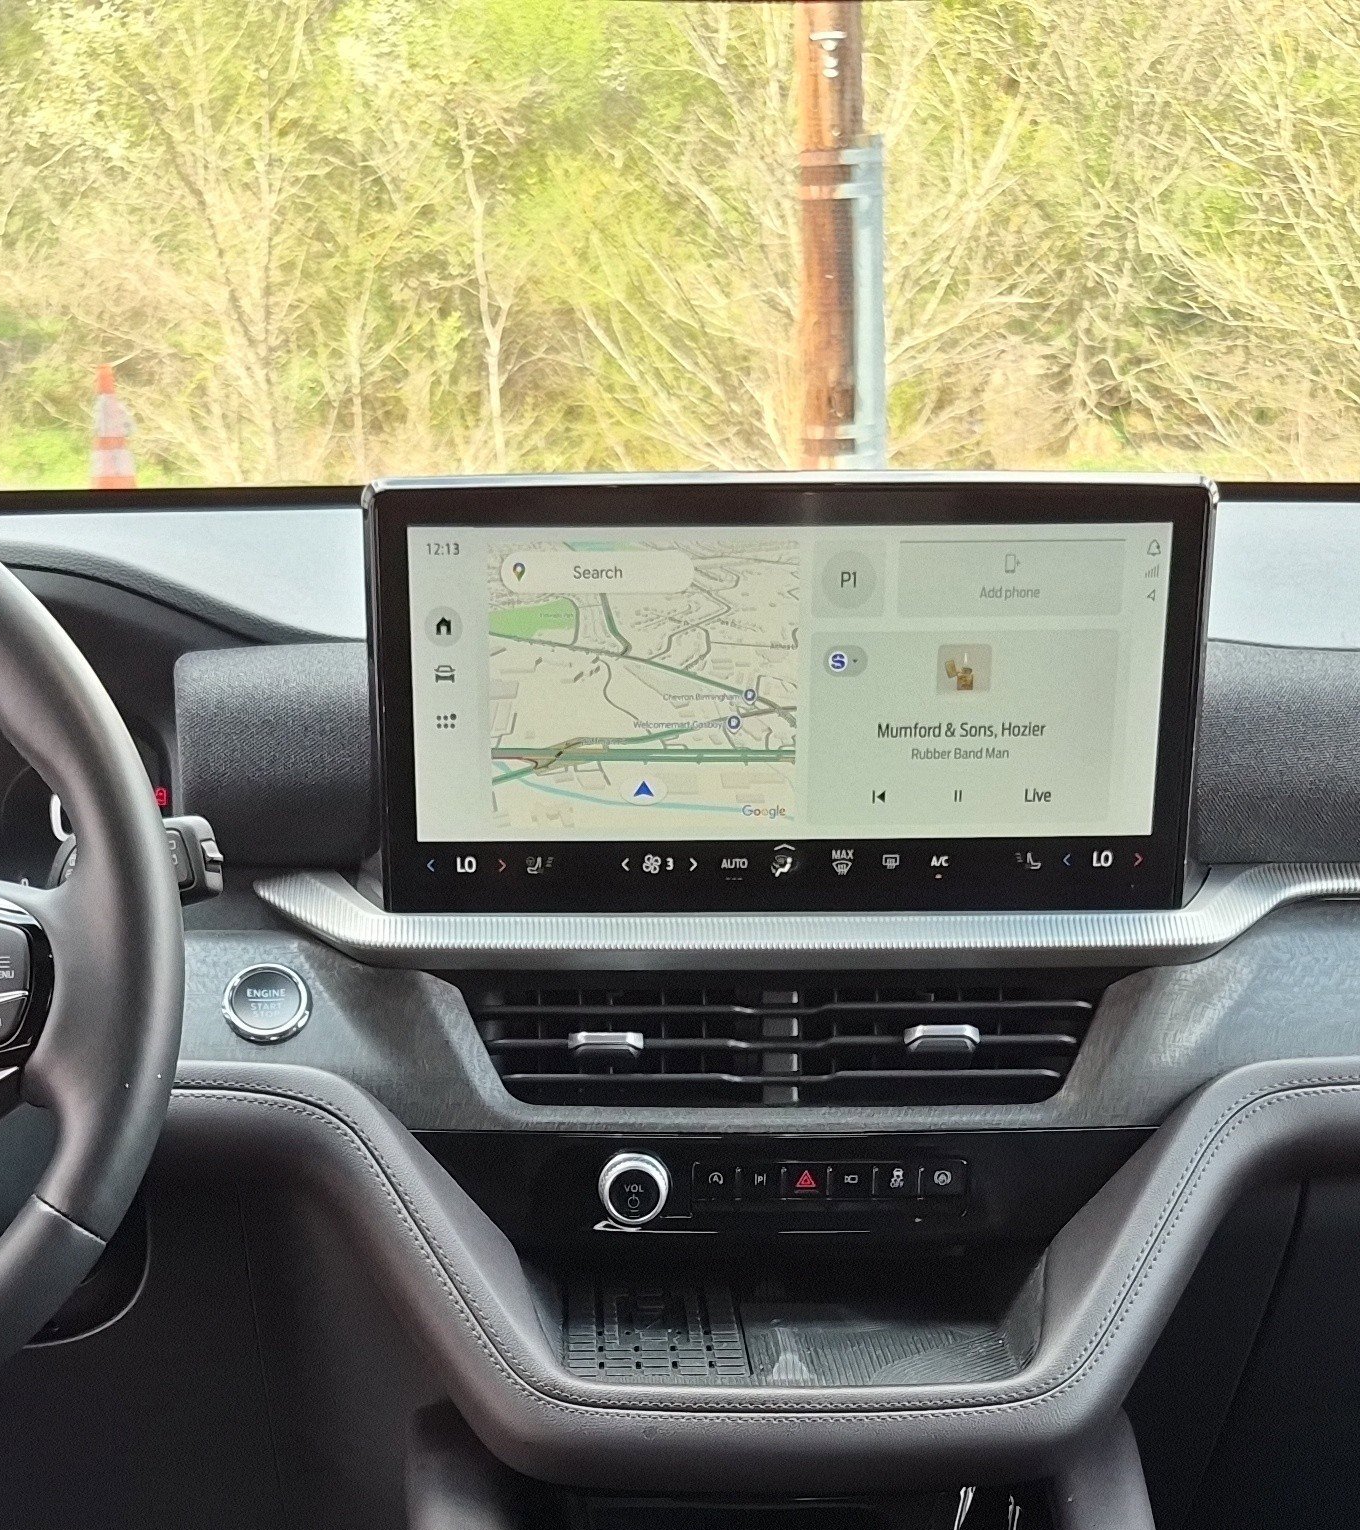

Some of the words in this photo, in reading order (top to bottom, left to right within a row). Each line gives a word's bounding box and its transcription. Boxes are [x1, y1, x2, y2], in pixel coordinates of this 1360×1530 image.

[426, 543, 460, 556] 12:13
[573, 565, 624, 580] Search
[840, 571, 858, 588] P1
[979, 585, 1003, 599] Add
[1004, 586, 1040, 602] phone
[877, 722, 941, 738] Mumford
[944, 722, 956, 738] &
[960, 722, 998, 739] Sons,
[1001, 721, 1046, 737] Hozier
[911, 748, 951, 760] Rubber
[954, 748, 983, 760] Band
[985, 748, 1010, 760] Man
[1024, 788, 1052, 803] Live
[741, 804, 786, 818] Google
[831, 850, 854, 860] MAX
[930, 855, 949, 867] A/C
[1092, 851, 1113, 868] LO
[456, 856, 477, 873] LO
[666, 857, 674, 870] 3
[721, 858, 748, 869] AUTO
[246, 988, 286, 998] ENGINE
[250, 1002, 282, 1011] START
[623, 1184, 645, 1193] VOL
